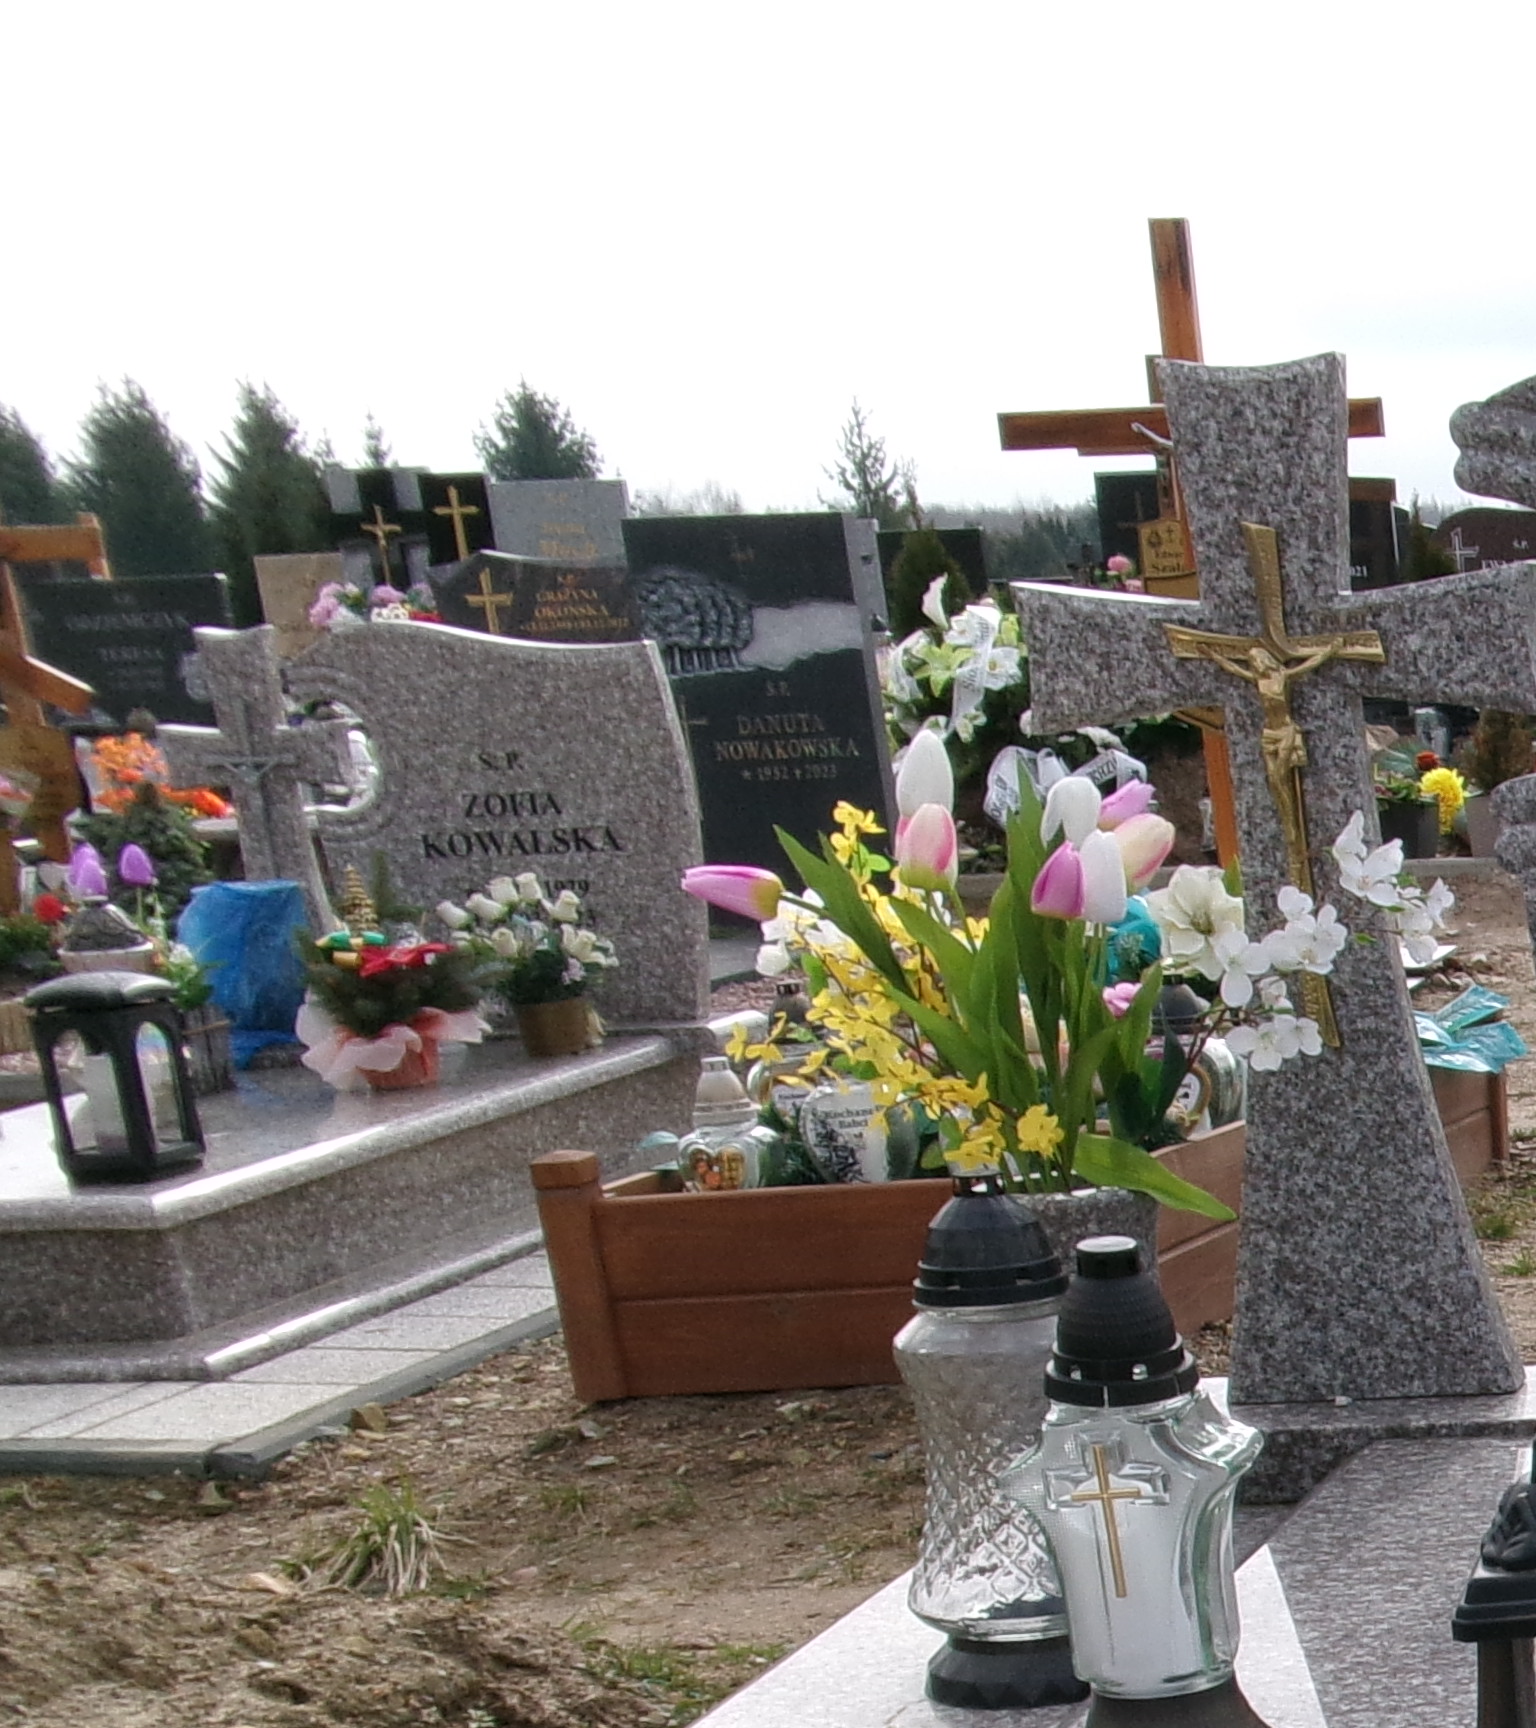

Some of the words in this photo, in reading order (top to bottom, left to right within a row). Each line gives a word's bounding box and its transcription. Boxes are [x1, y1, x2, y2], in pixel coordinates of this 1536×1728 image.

[736, 713, 825, 736] DANUTA
[714, 736, 860, 763] NOWAKOWSKA
[462, 791, 563, 819] ZOFIA
[421, 825, 626, 860] KOWALSKA
